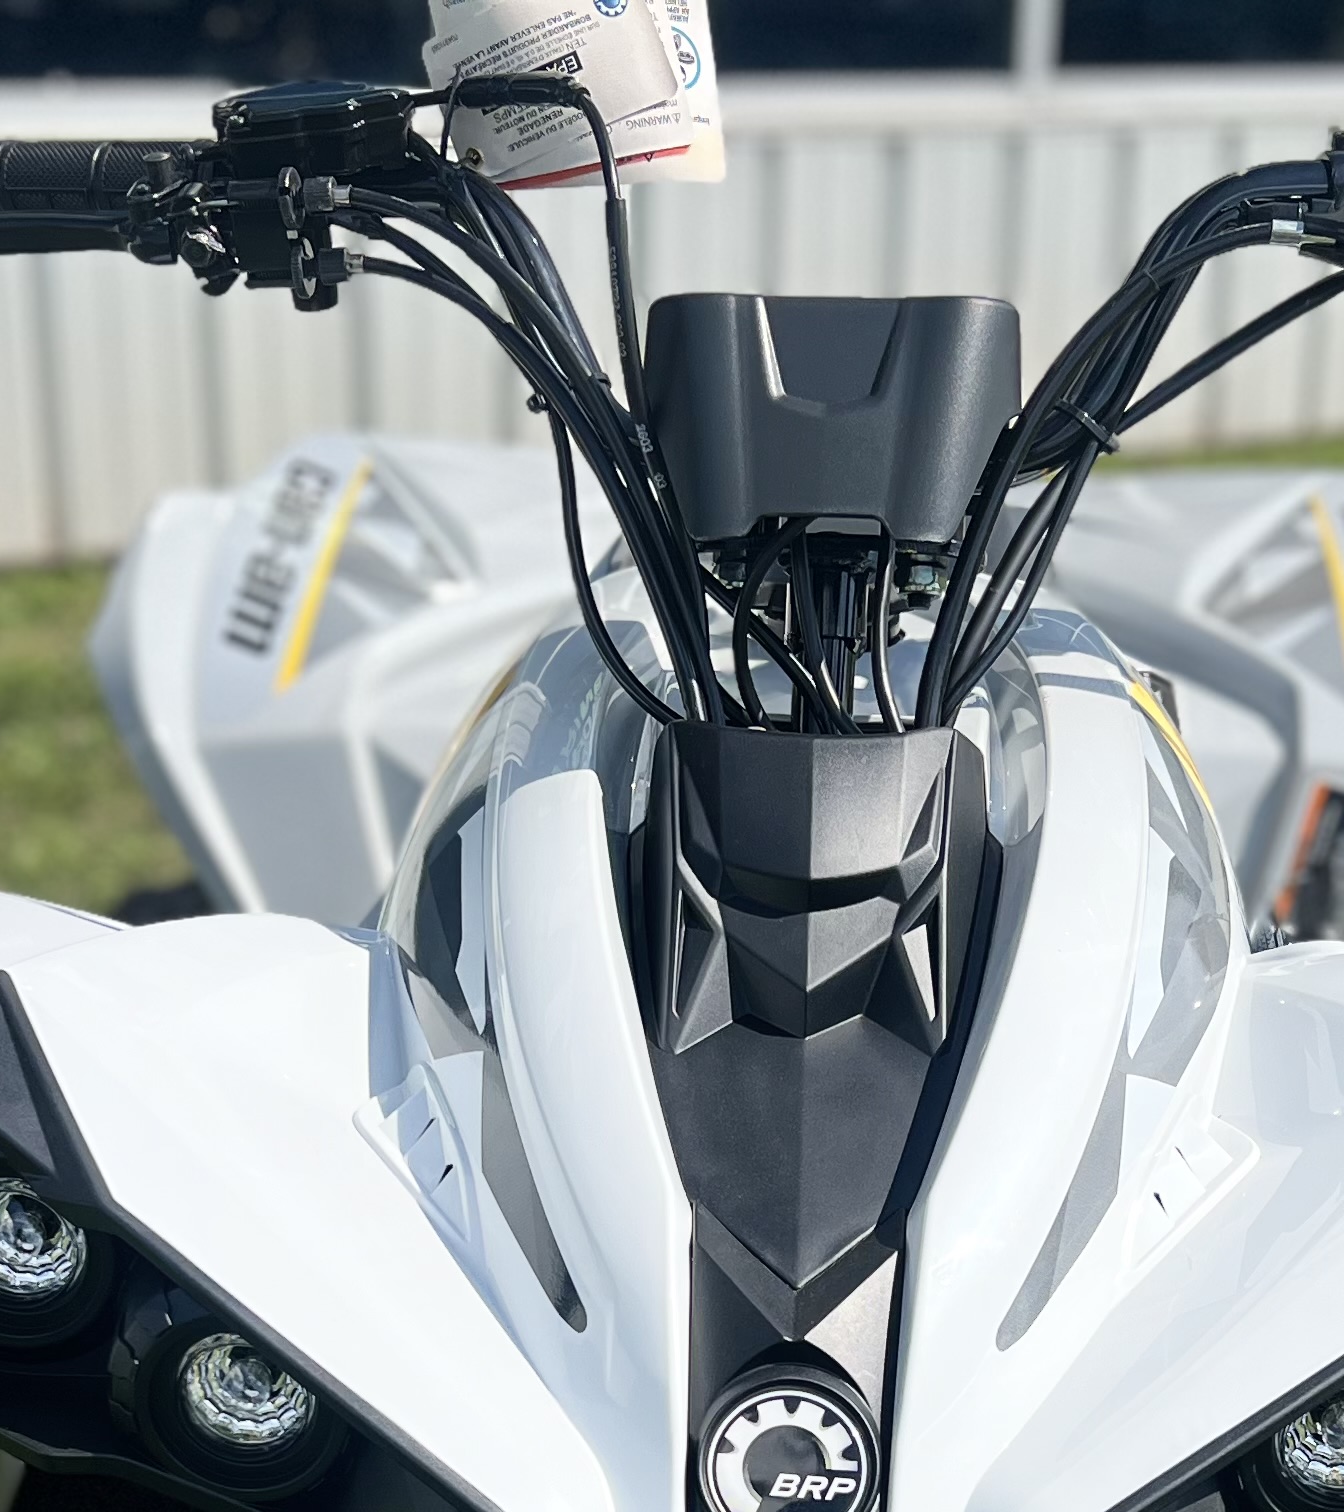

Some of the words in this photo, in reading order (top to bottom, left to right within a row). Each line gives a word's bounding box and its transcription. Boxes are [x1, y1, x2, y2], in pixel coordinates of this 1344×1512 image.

[541, 14, 591, 40] BOMBARDIER
[546, 14, 562, 26] PAS
[509, 21, 546, 42] ENLEVER
[485, 38, 510, 54] AVANT
[501, 35, 541, 58] PRODUITS
[565, 36, 587, 51] TEN
[474, 50, 485, 59] LA
[516, 108, 564, 136] RENEGADE
[525, 109, 538, 120] DU
[626, 114, 672, 130] WARNING
[544, 124, 558, 135] DU
[769, 1472, 857, 1501] BRP
